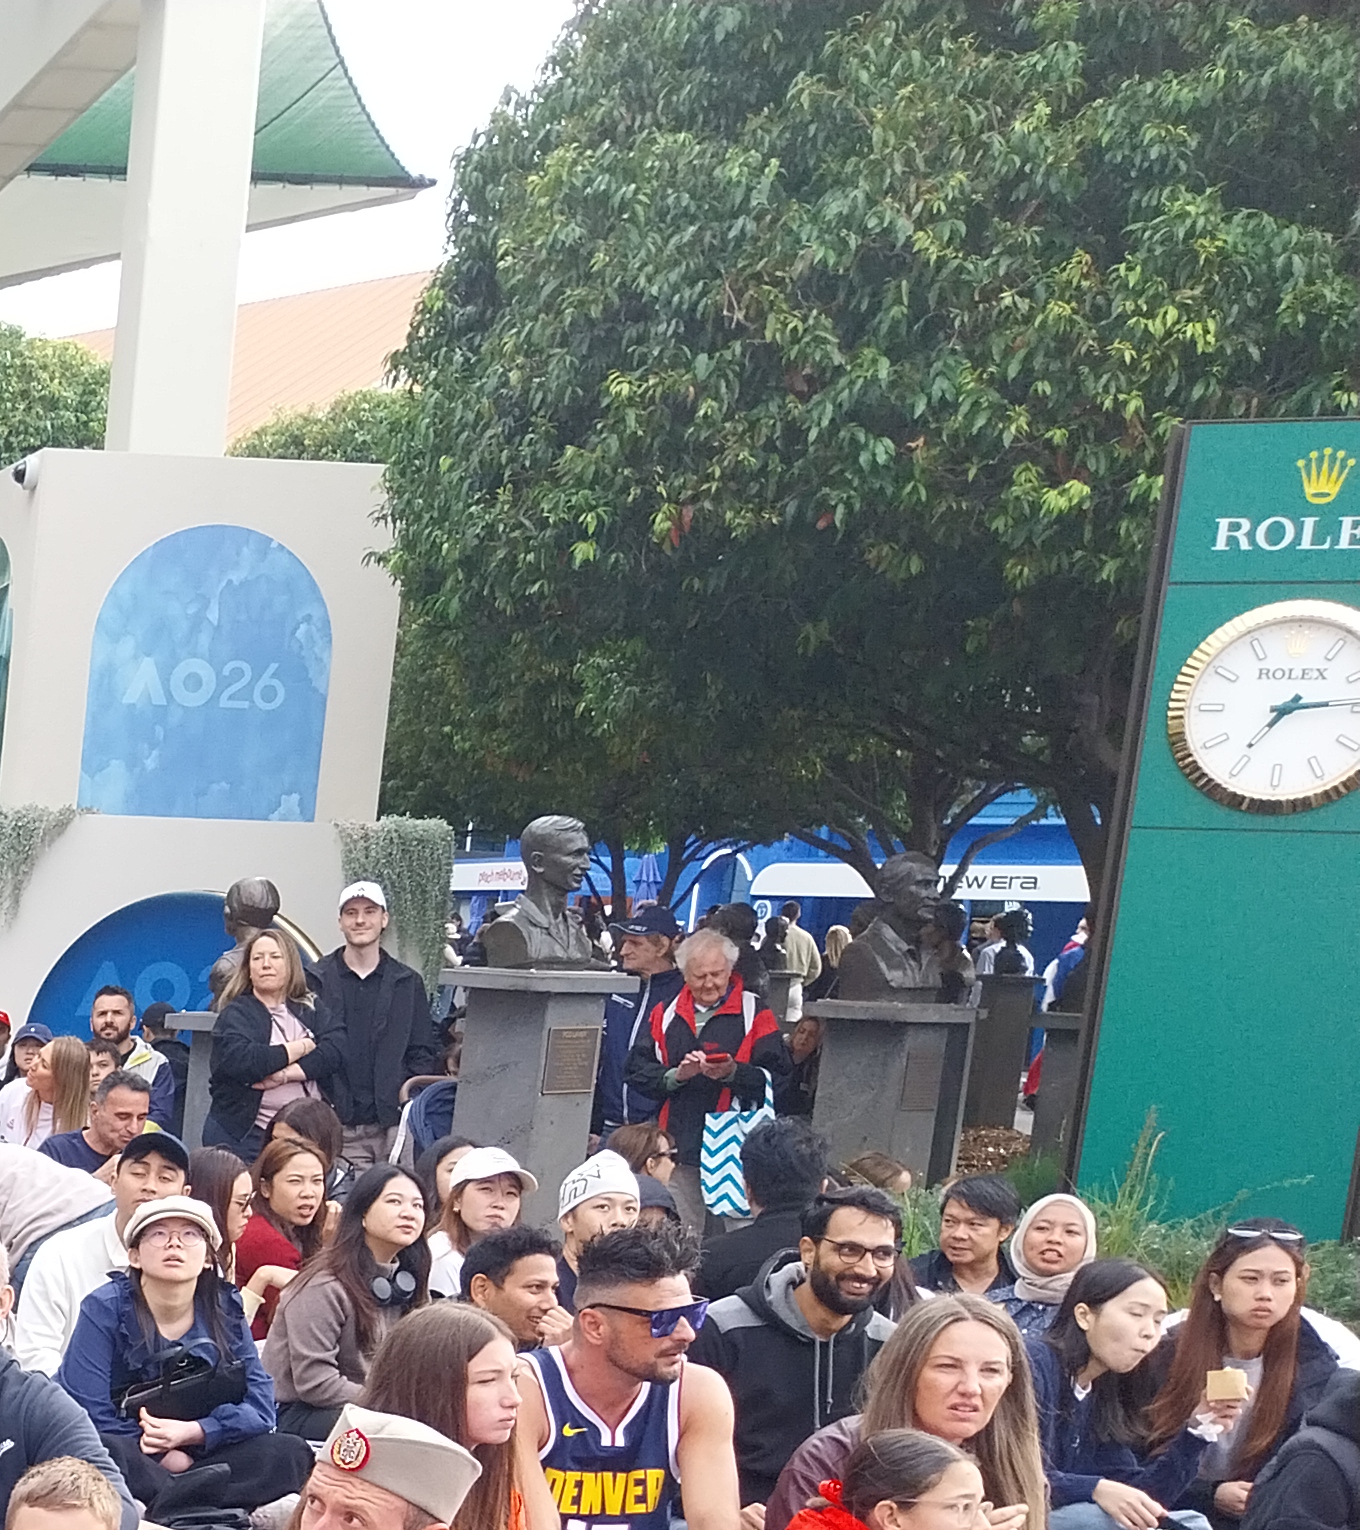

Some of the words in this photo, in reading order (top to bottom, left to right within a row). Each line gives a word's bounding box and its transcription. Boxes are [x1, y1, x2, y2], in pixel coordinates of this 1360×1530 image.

[122, 656, 285, 710] AO26
[1256, 667, 1329, 680] ROLEX
[545, 1467, 666, 1515] DENVER
